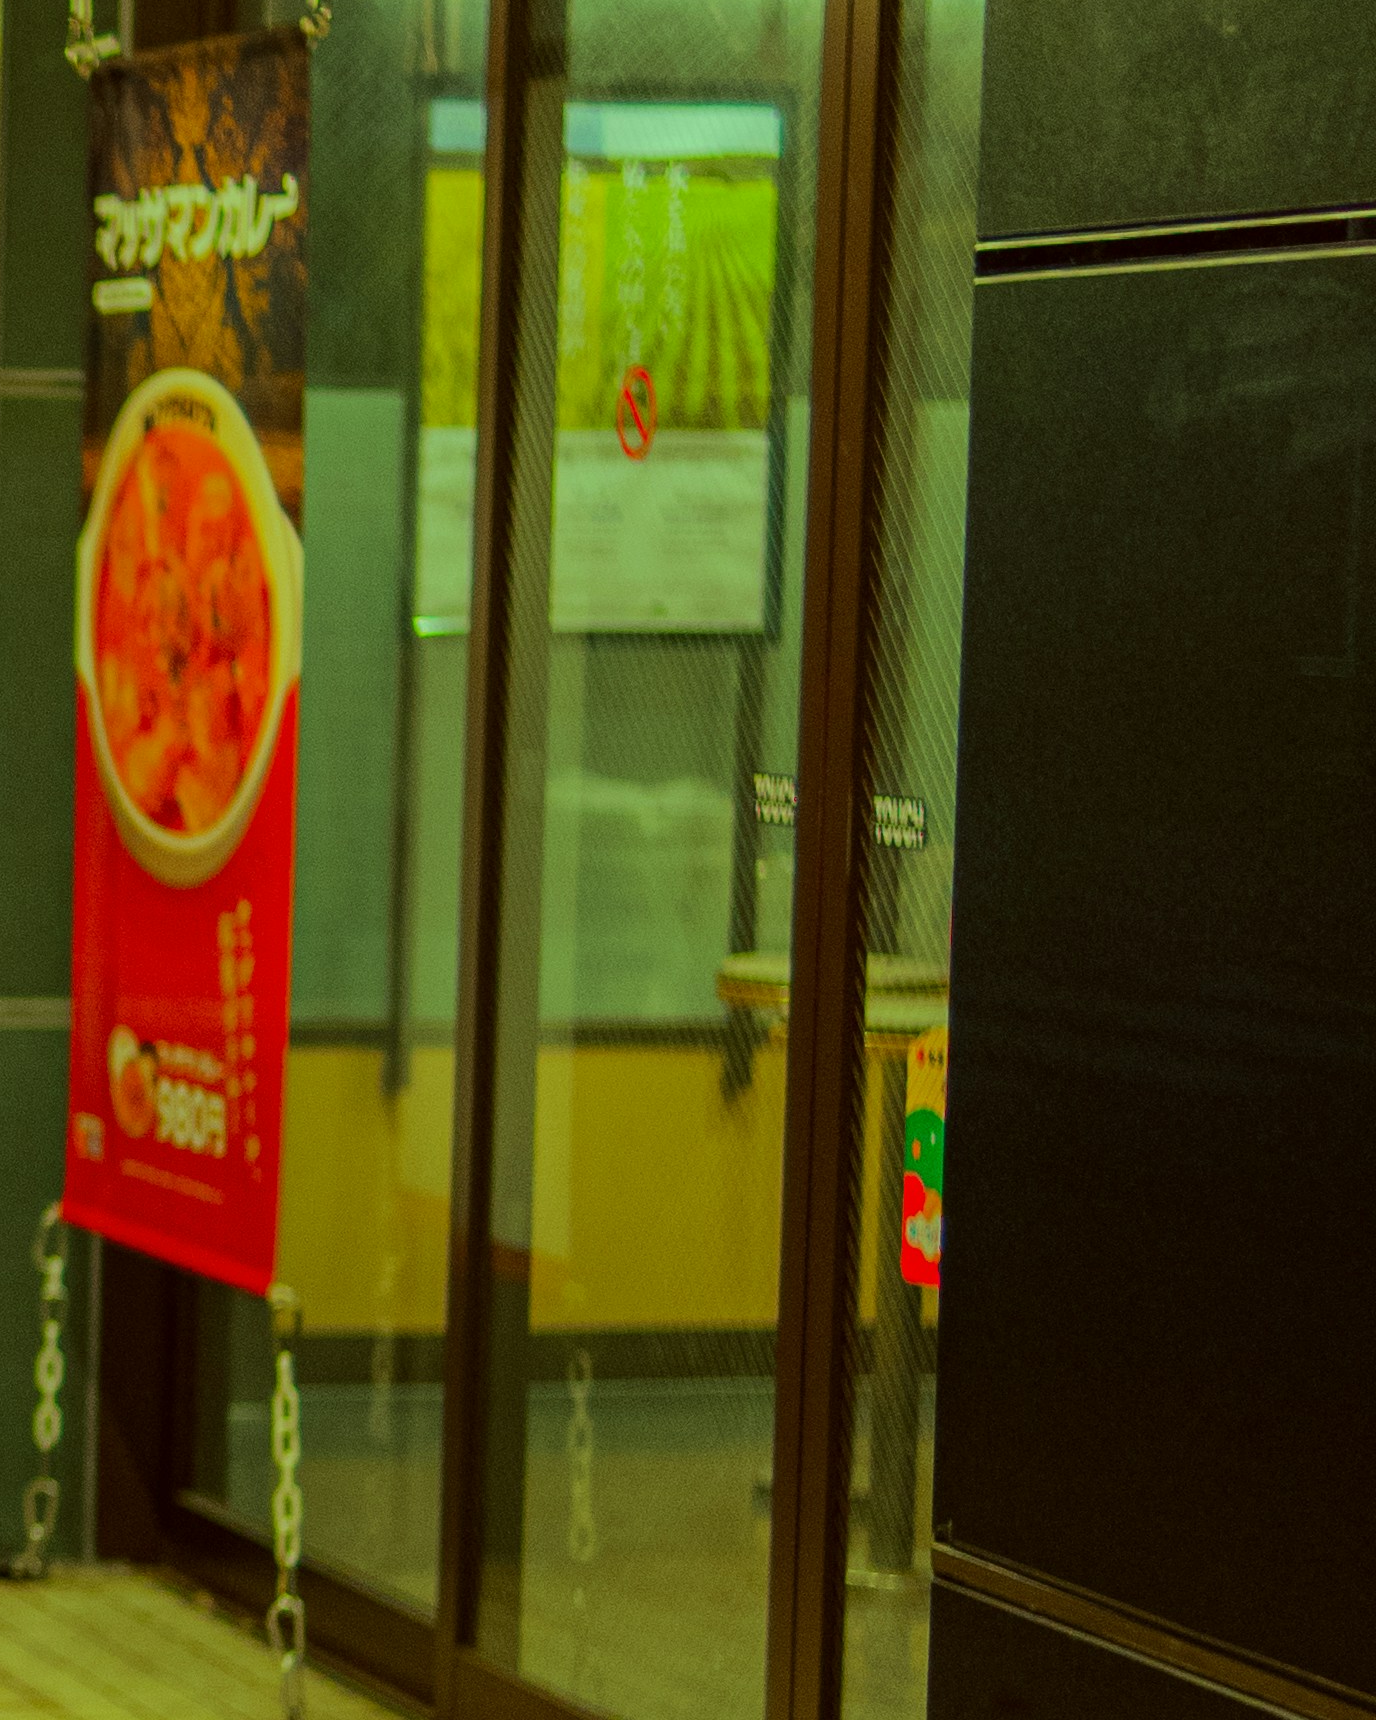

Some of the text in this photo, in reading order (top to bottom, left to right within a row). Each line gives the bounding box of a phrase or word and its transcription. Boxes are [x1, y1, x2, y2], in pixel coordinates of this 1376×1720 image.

[94, 172, 299, 271] マッサマンカレー
